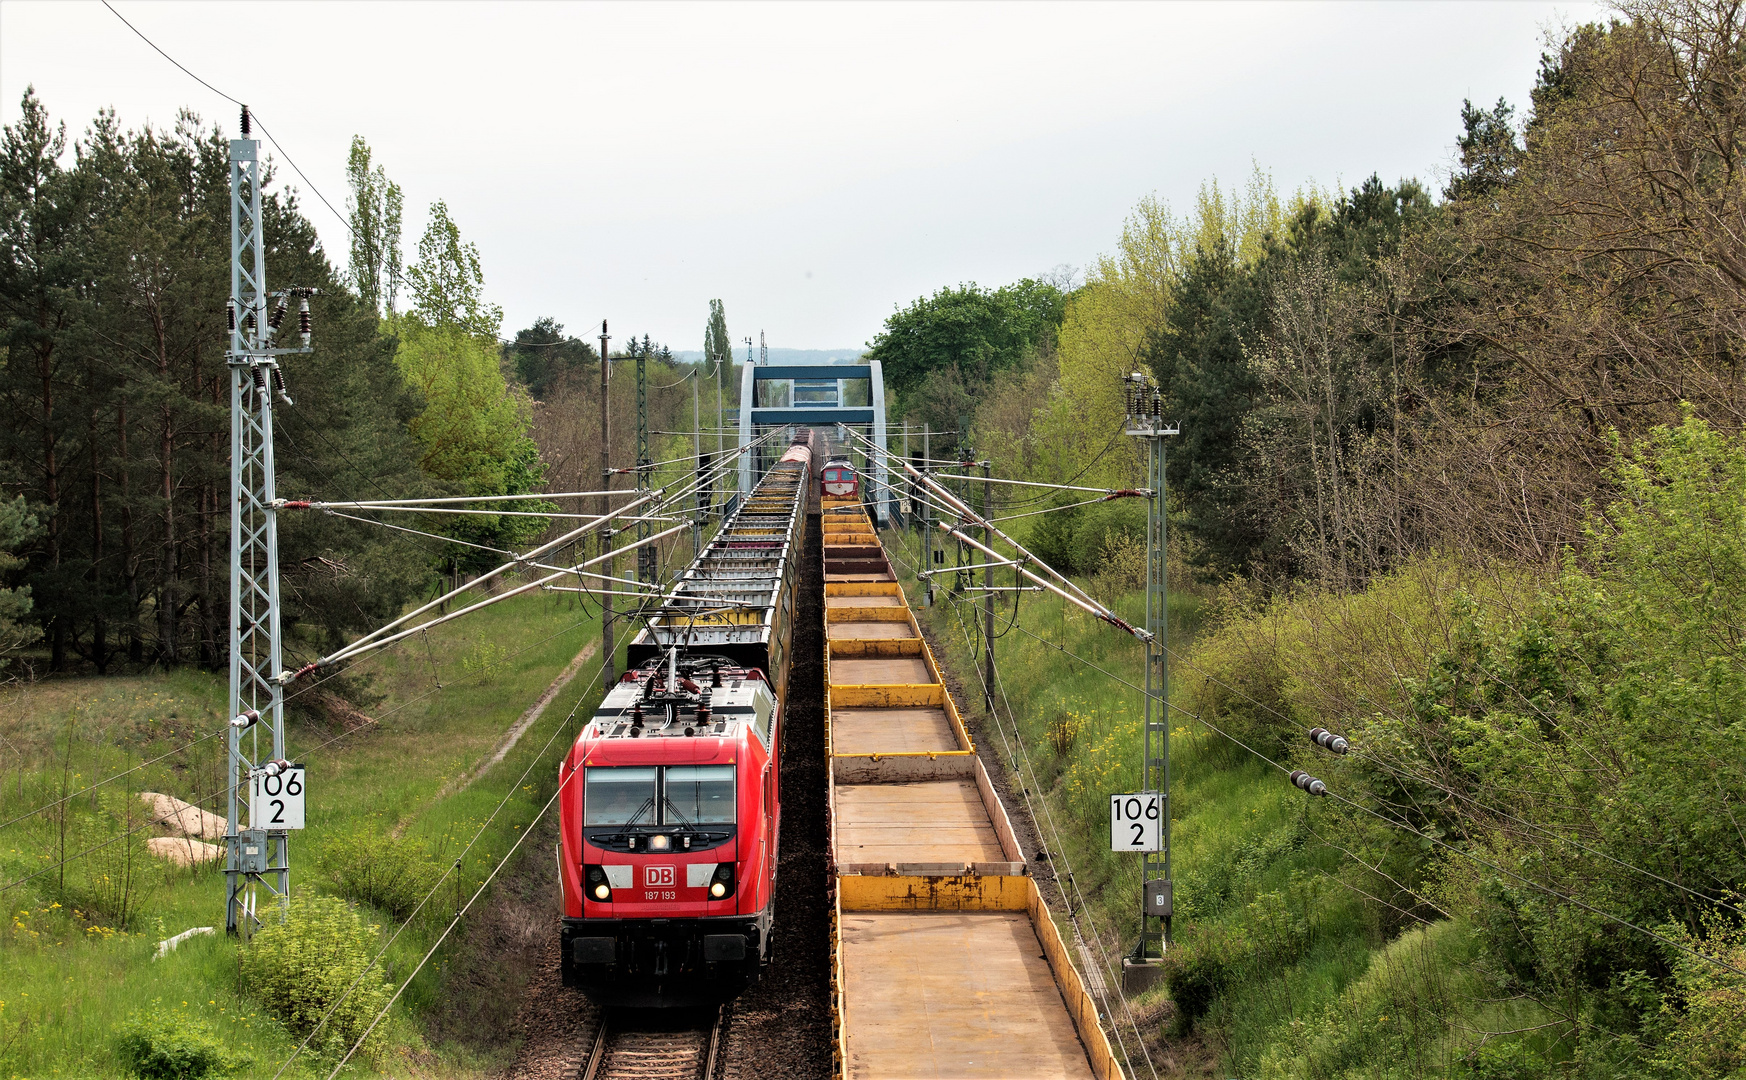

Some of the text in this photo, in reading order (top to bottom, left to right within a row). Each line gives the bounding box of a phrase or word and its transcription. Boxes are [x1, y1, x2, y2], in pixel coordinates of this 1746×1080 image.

[254, 772, 302, 796] 106
[270, 800, 284, 823] 2
[1113, 797, 1159, 820] 106
[1130, 823, 1144, 845] 2
[648, 869, 672, 883] DB
[645, 891, 676, 900] 187 193
[1158, 896, 1163, 904] 3
